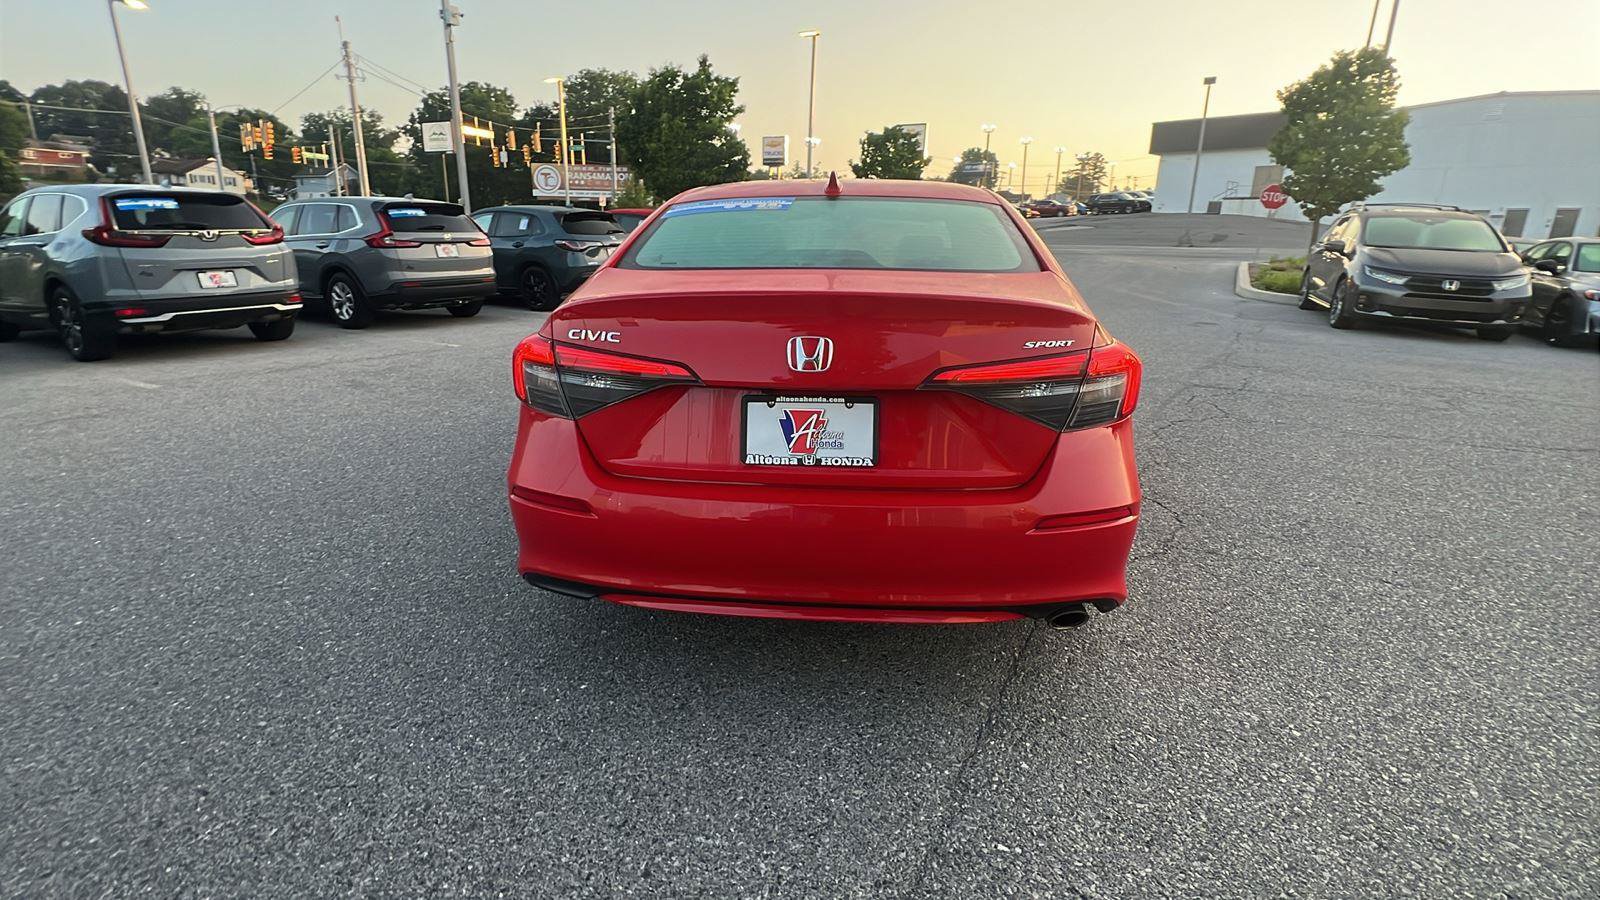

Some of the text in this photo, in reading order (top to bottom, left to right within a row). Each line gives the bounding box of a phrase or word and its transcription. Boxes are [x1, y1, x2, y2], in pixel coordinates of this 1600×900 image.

[1262, 192, 1288, 203] STOP
[568, 329, 621, 343] CIVIC
[1023, 340, 1076, 349] SPORT
[775, 396, 845, 404] altoonahonda.com
[811, 438, 844, 450] Honda
[745, 453, 798, 465] Altoona
[820, 457, 874, 467] HONDA
